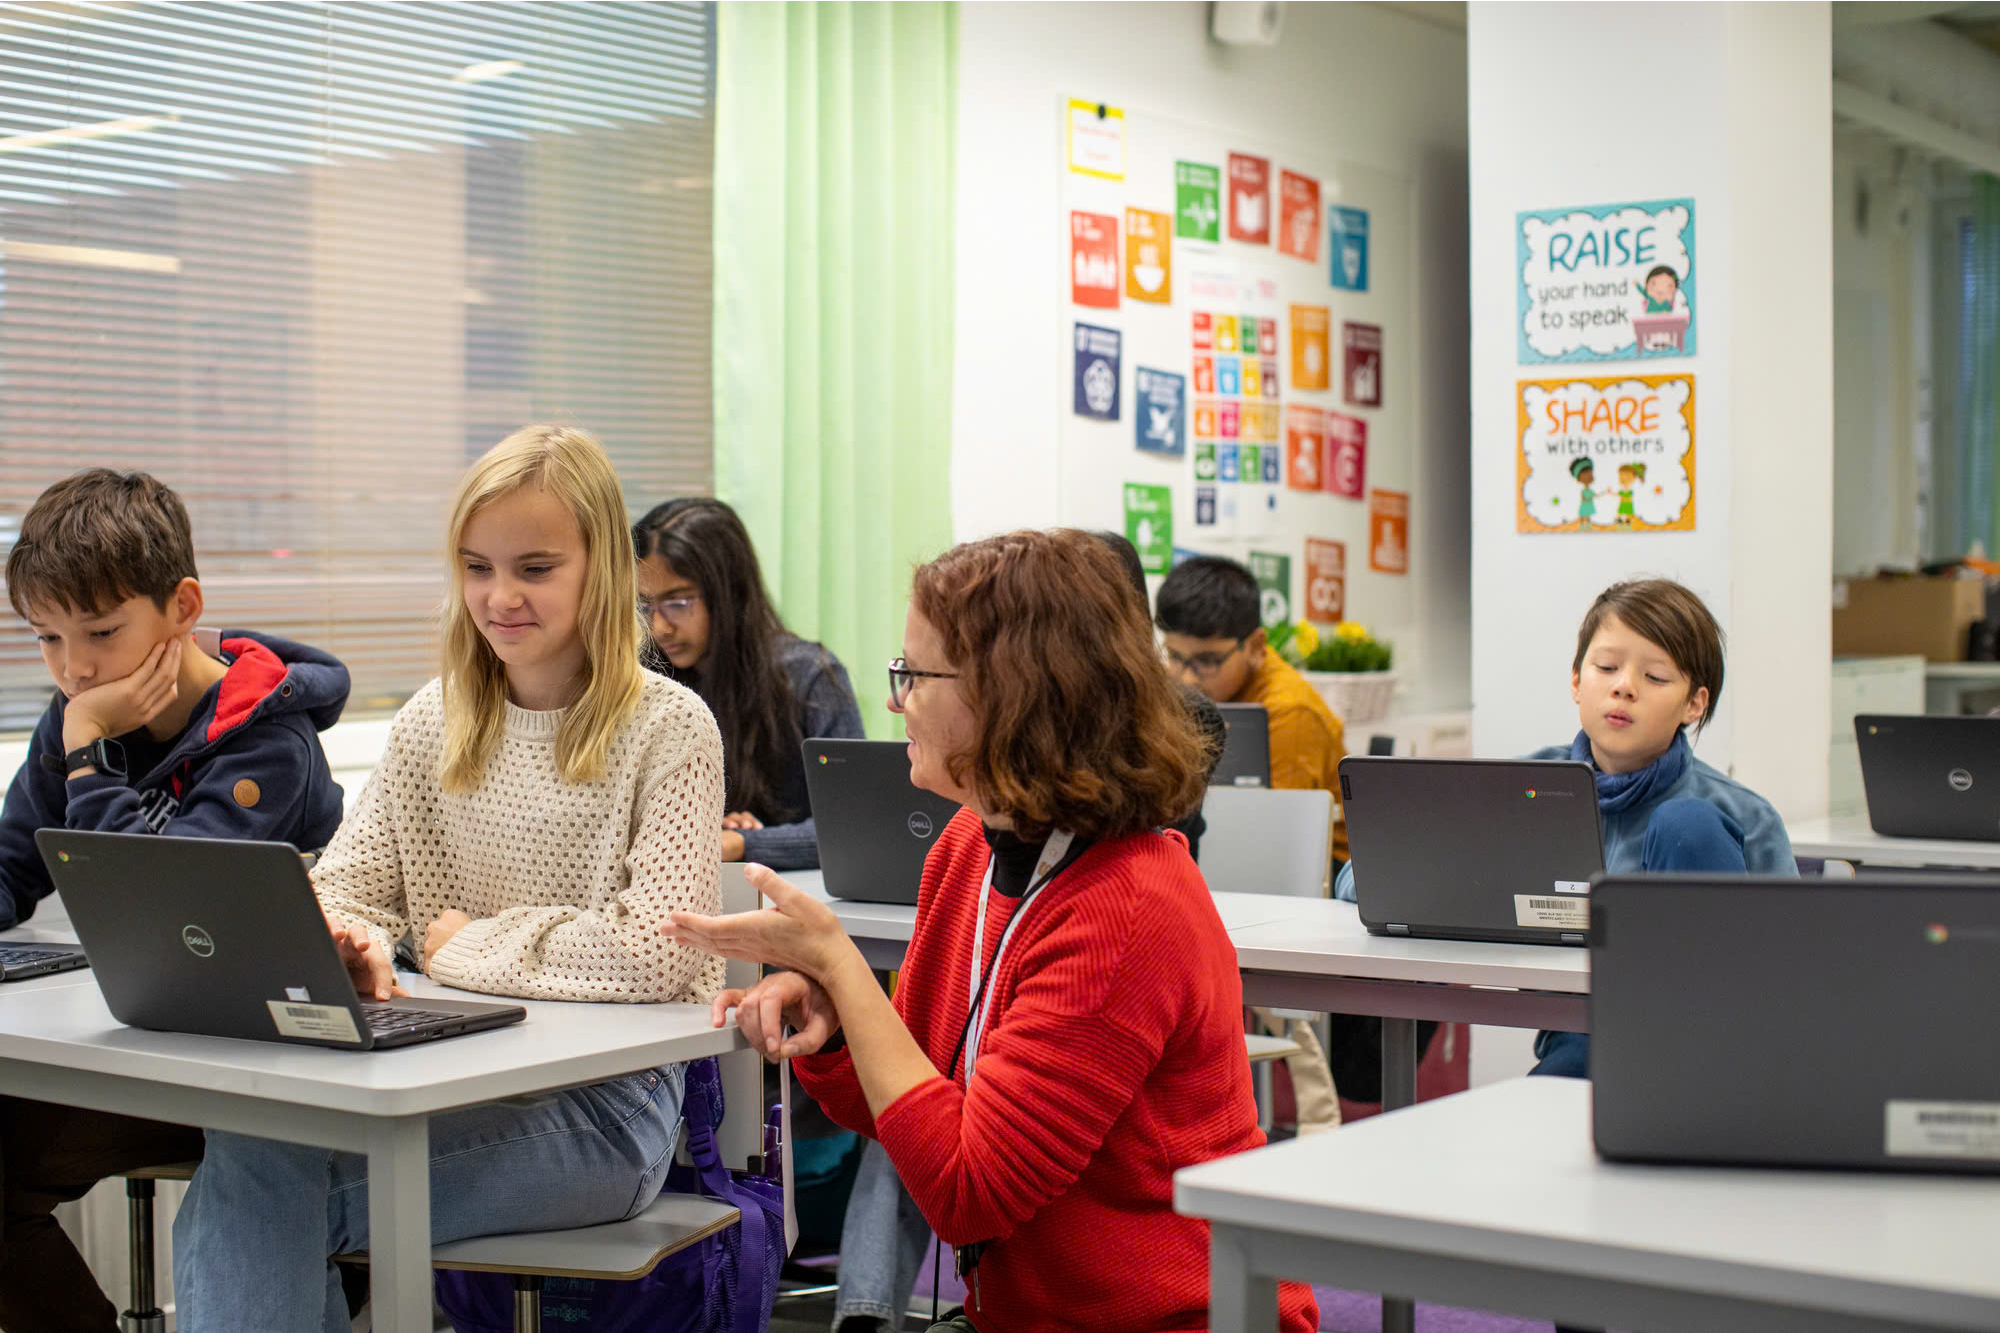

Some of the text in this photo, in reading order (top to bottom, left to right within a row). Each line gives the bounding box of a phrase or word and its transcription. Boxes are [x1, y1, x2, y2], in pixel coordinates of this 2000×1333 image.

[1548, 226, 1656, 273] RAISE
[1539, 278, 1629, 304] your hand
[1540, 304, 1630, 332] to speak
[1545, 396, 1660, 435] SHARE
[1546, 436, 1665, 455] with others
